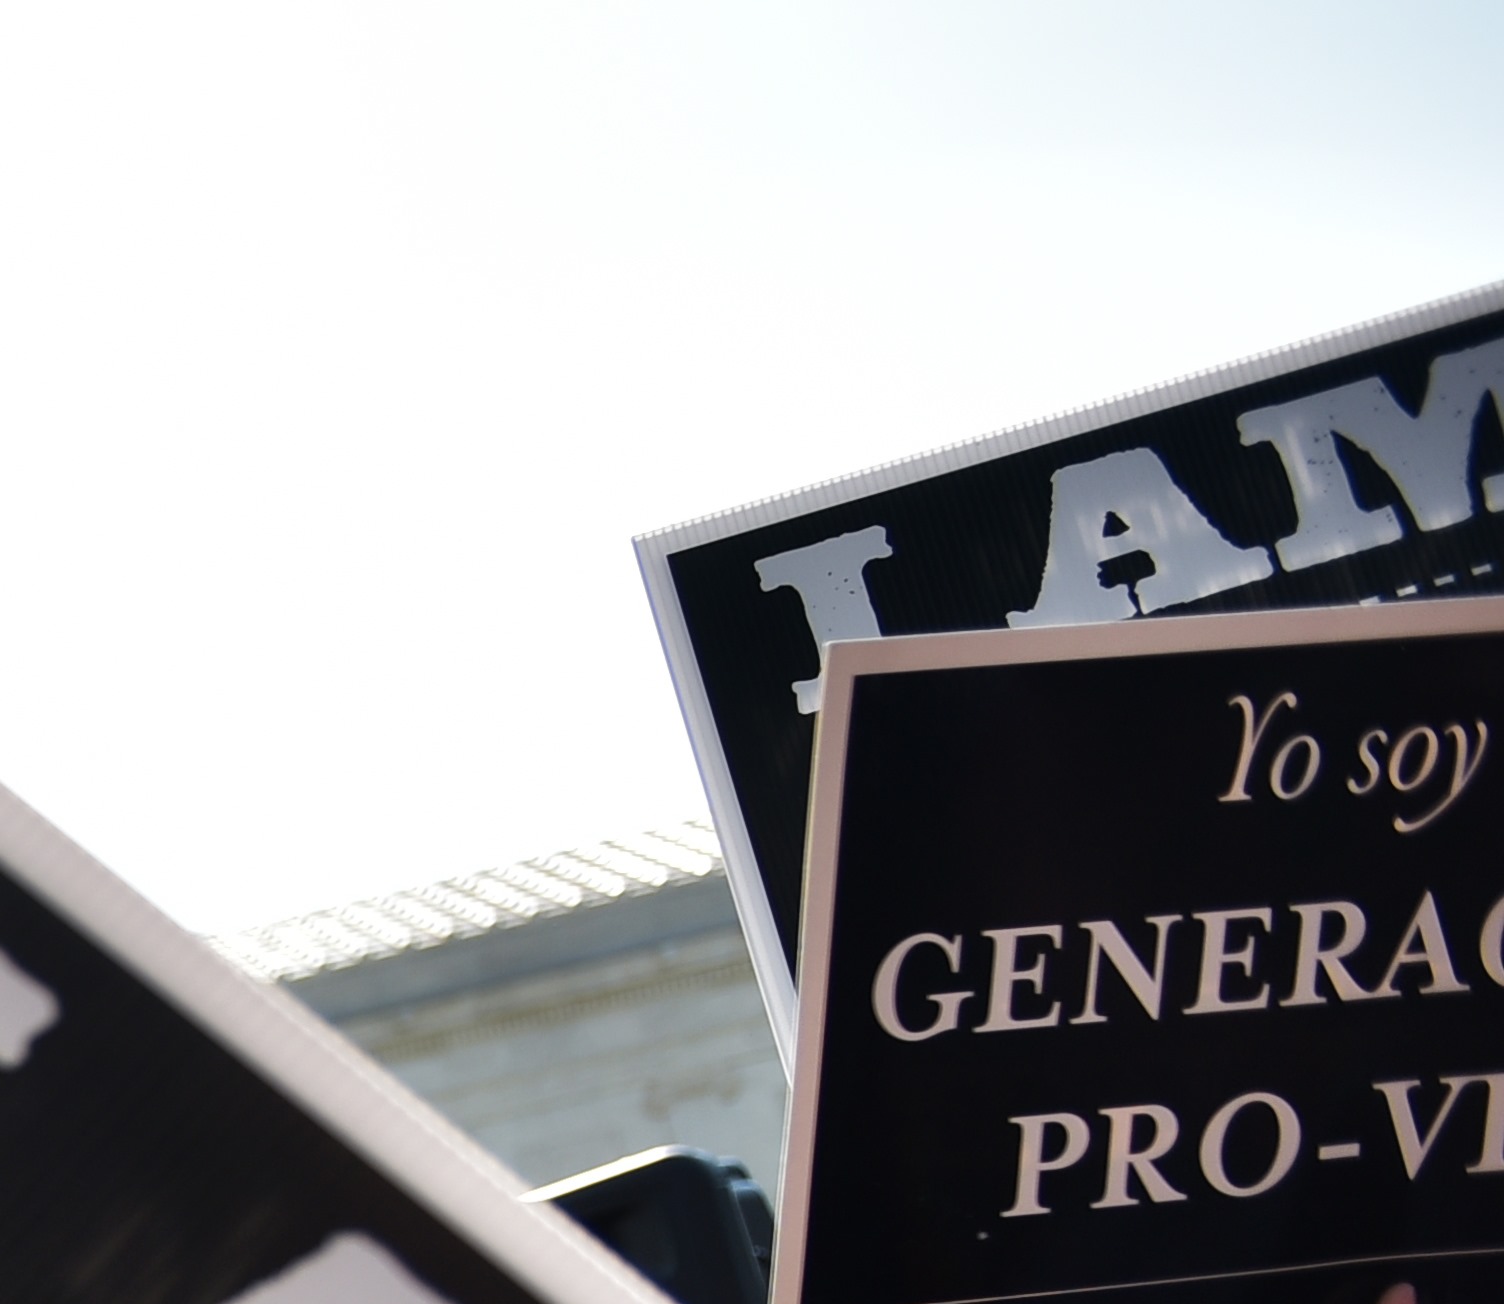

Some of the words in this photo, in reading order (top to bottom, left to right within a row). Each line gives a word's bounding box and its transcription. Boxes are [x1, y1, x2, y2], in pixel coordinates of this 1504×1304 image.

[754, 524, 893, 714] I
[1006, 336, 1504, 630] AM
[1217, 691, 1322, 802] Yo
[1346, 719, 1488, 834] soy
[872, 888, 1504, 1042] GENERA
